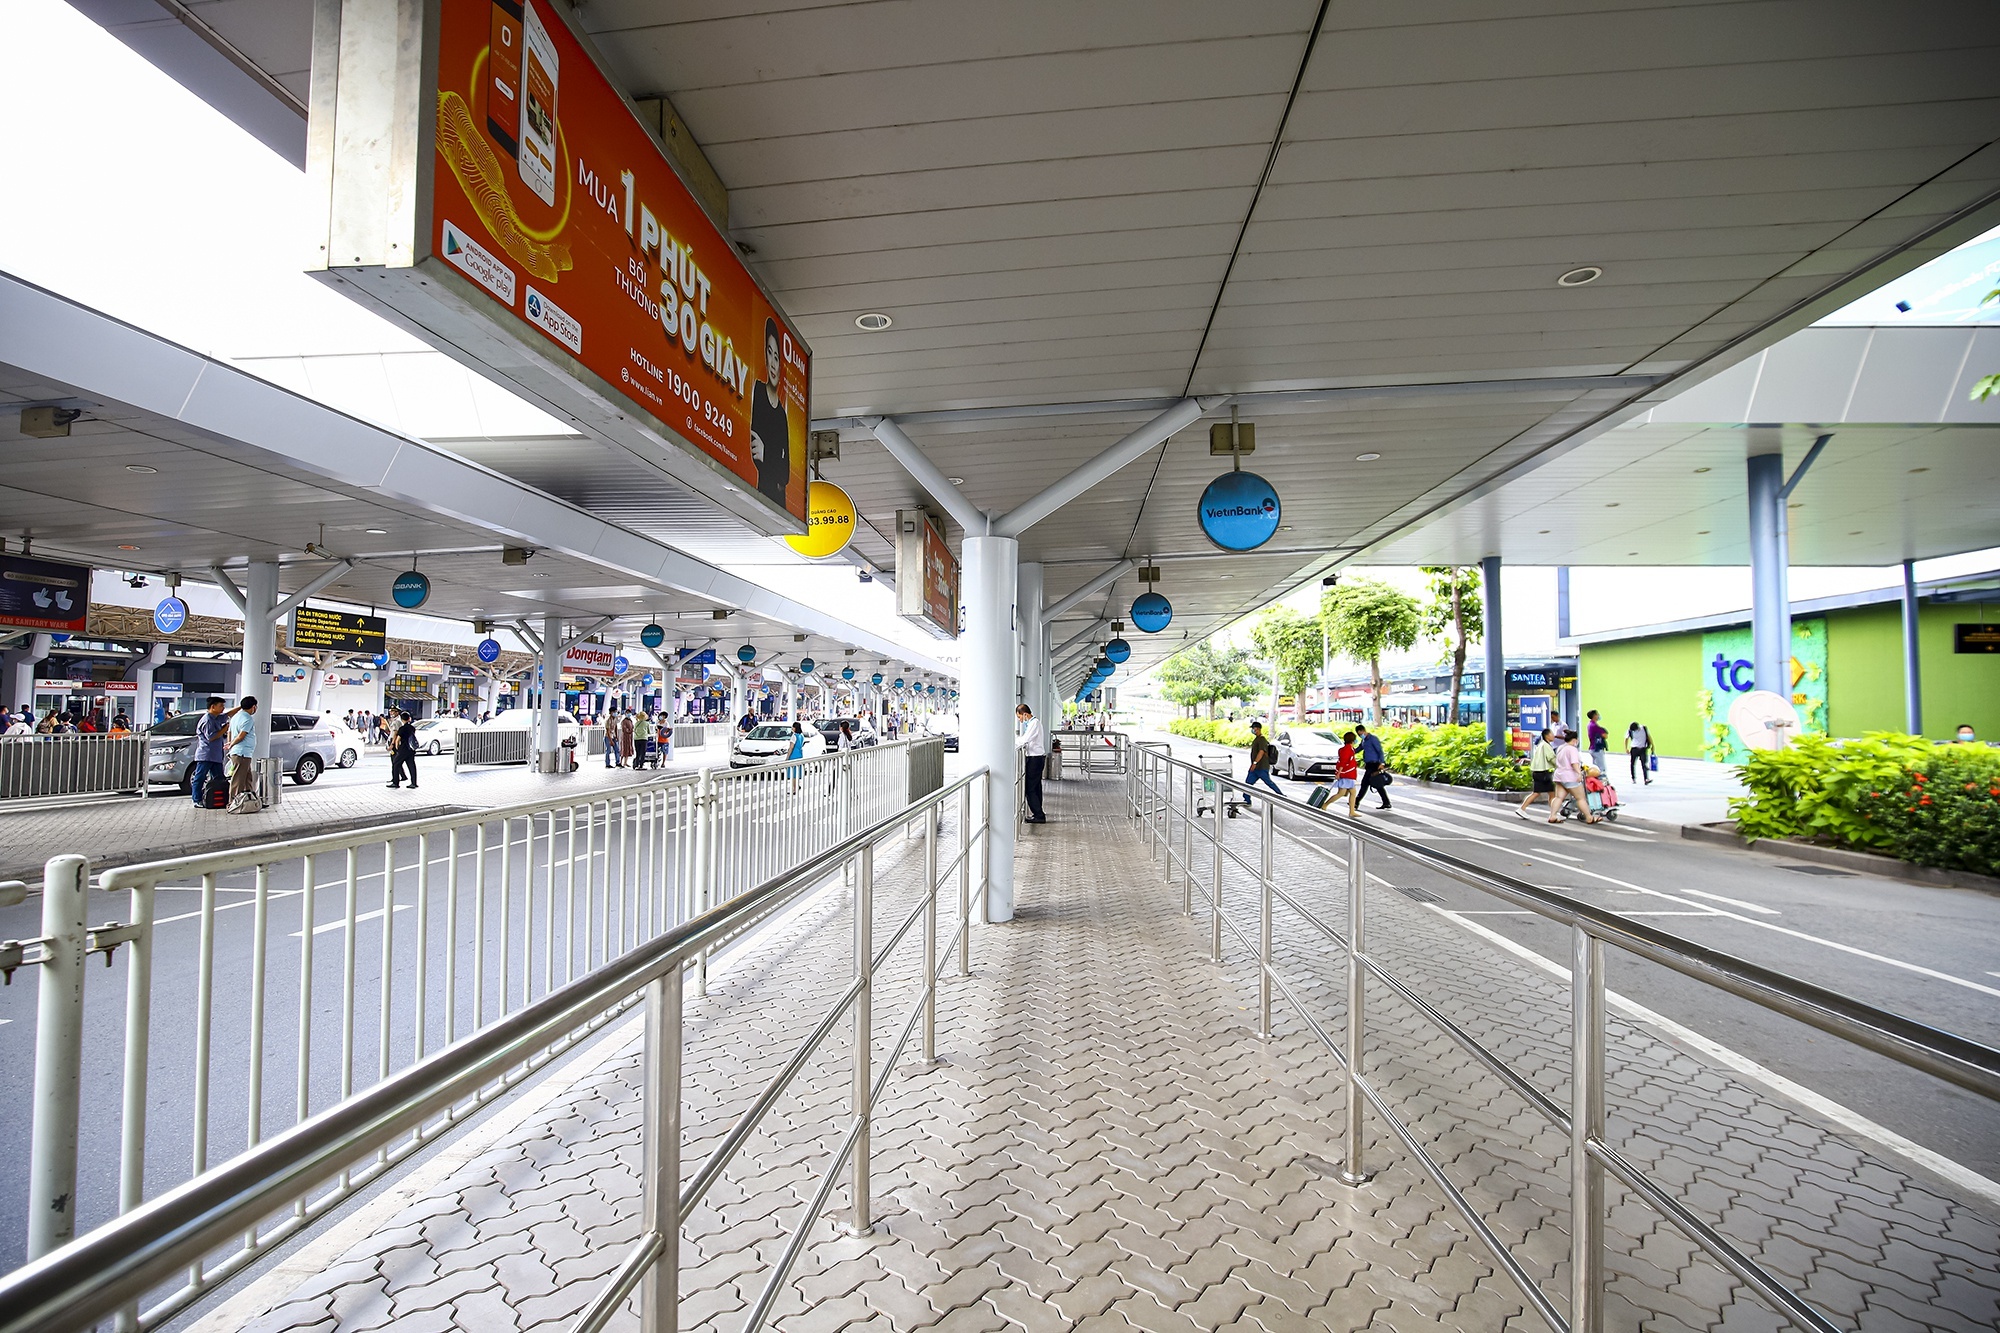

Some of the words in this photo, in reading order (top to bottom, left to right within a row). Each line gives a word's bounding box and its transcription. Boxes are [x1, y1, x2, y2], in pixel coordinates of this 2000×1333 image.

[578, 158, 618, 223] MUA
[621, 169, 634, 238] 1
[640, 202, 711, 317] PHÚT
[464, 253, 494, 283] Google
[496, 276, 511, 297] play
[465, 243, 492, 266] ANDROID
[492, 263, 503, 275] APP
[504, 272, 512, 282] ON
[614, 266, 658, 320] THƯỜNG
[543, 301, 566, 322] Download
[543, 312, 559, 333] App
[560, 324, 578, 346] Store
[659, 279, 697, 354] 30
[700, 322, 748, 399] GIÂY
[630, 377, 663, 406] www.lian.vn
[630, 347, 663, 383] HOTLINE
[667, 368, 700, 411] 1900
[705, 400, 733, 438] 9249
[1206, 506, 1264, 518] VietinBank
[16, 618, 48, 628] SANITARY
[50, 621, 68, 629] WARE
[297, 616, 317, 624] Domestic
[312, 611, 328, 619] TRONG
[1512, 673, 1545, 682] SANTEA
